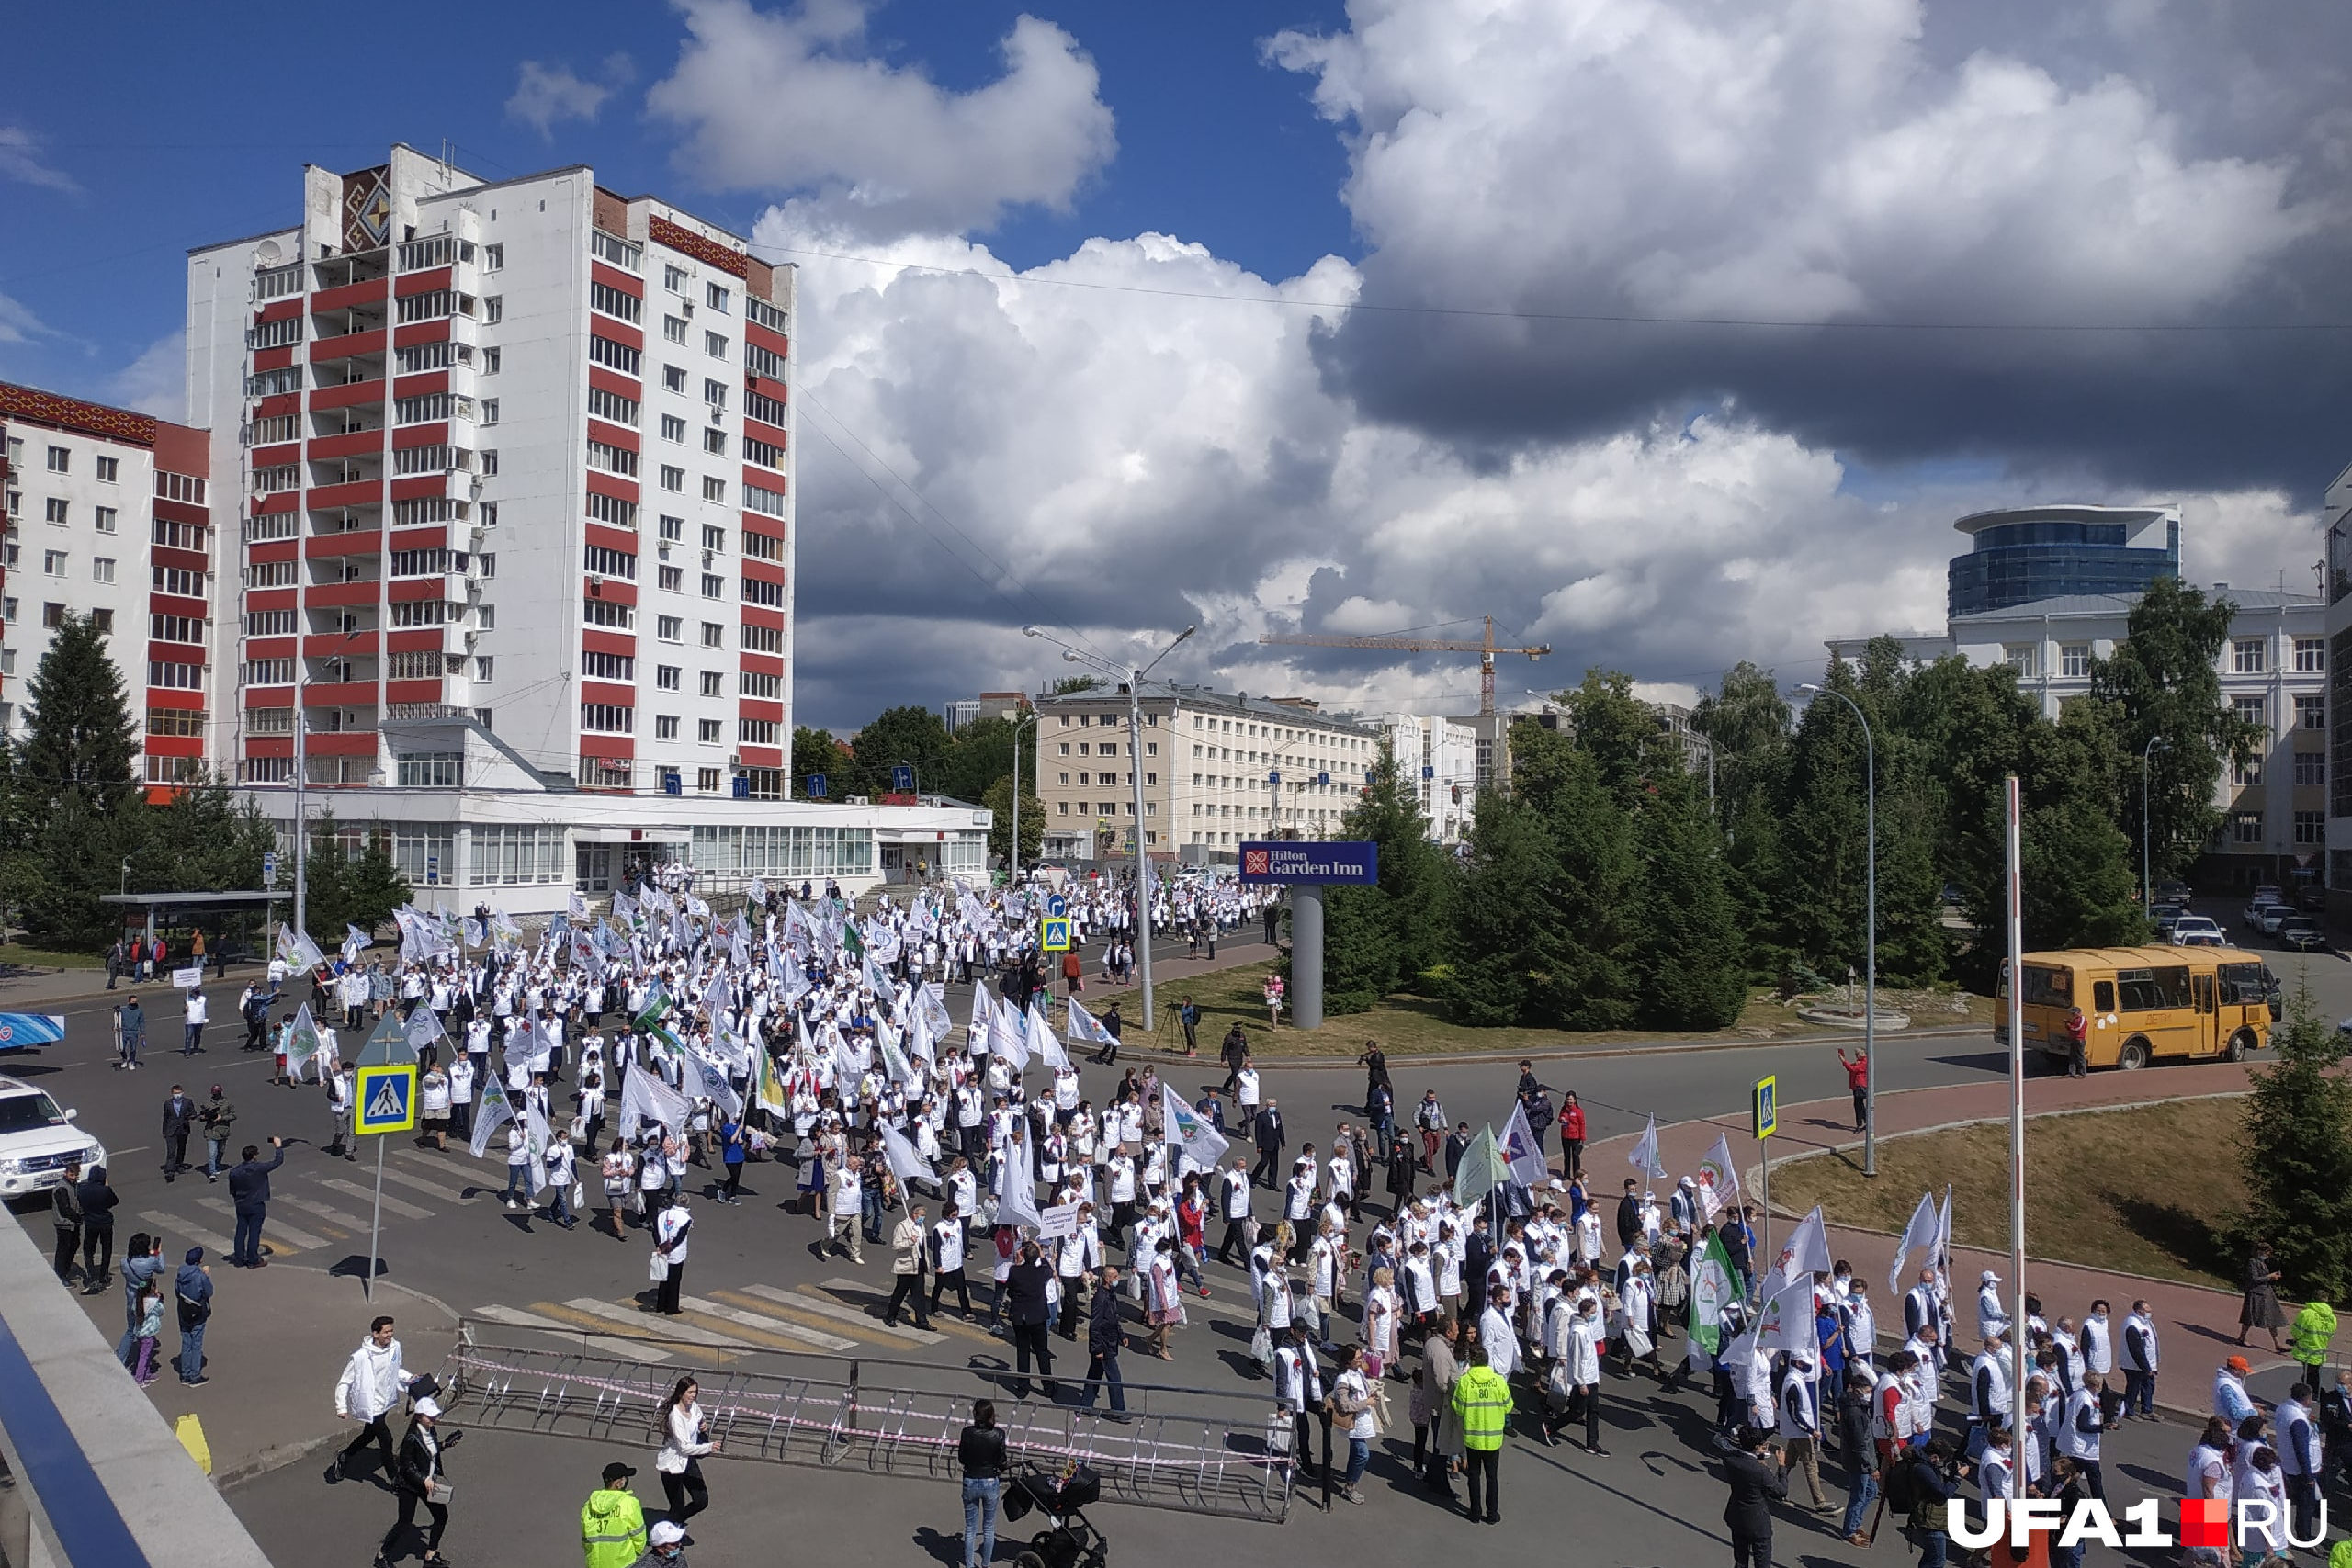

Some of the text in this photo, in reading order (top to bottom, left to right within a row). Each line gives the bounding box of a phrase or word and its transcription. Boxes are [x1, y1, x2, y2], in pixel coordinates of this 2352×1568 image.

[1270, 850, 1308, 861] Hilton
[1269, 860, 1364, 876] Garden Inn
[1478, 1388, 1489, 1399] 80
[596, 1519, 609, 1534] 37
